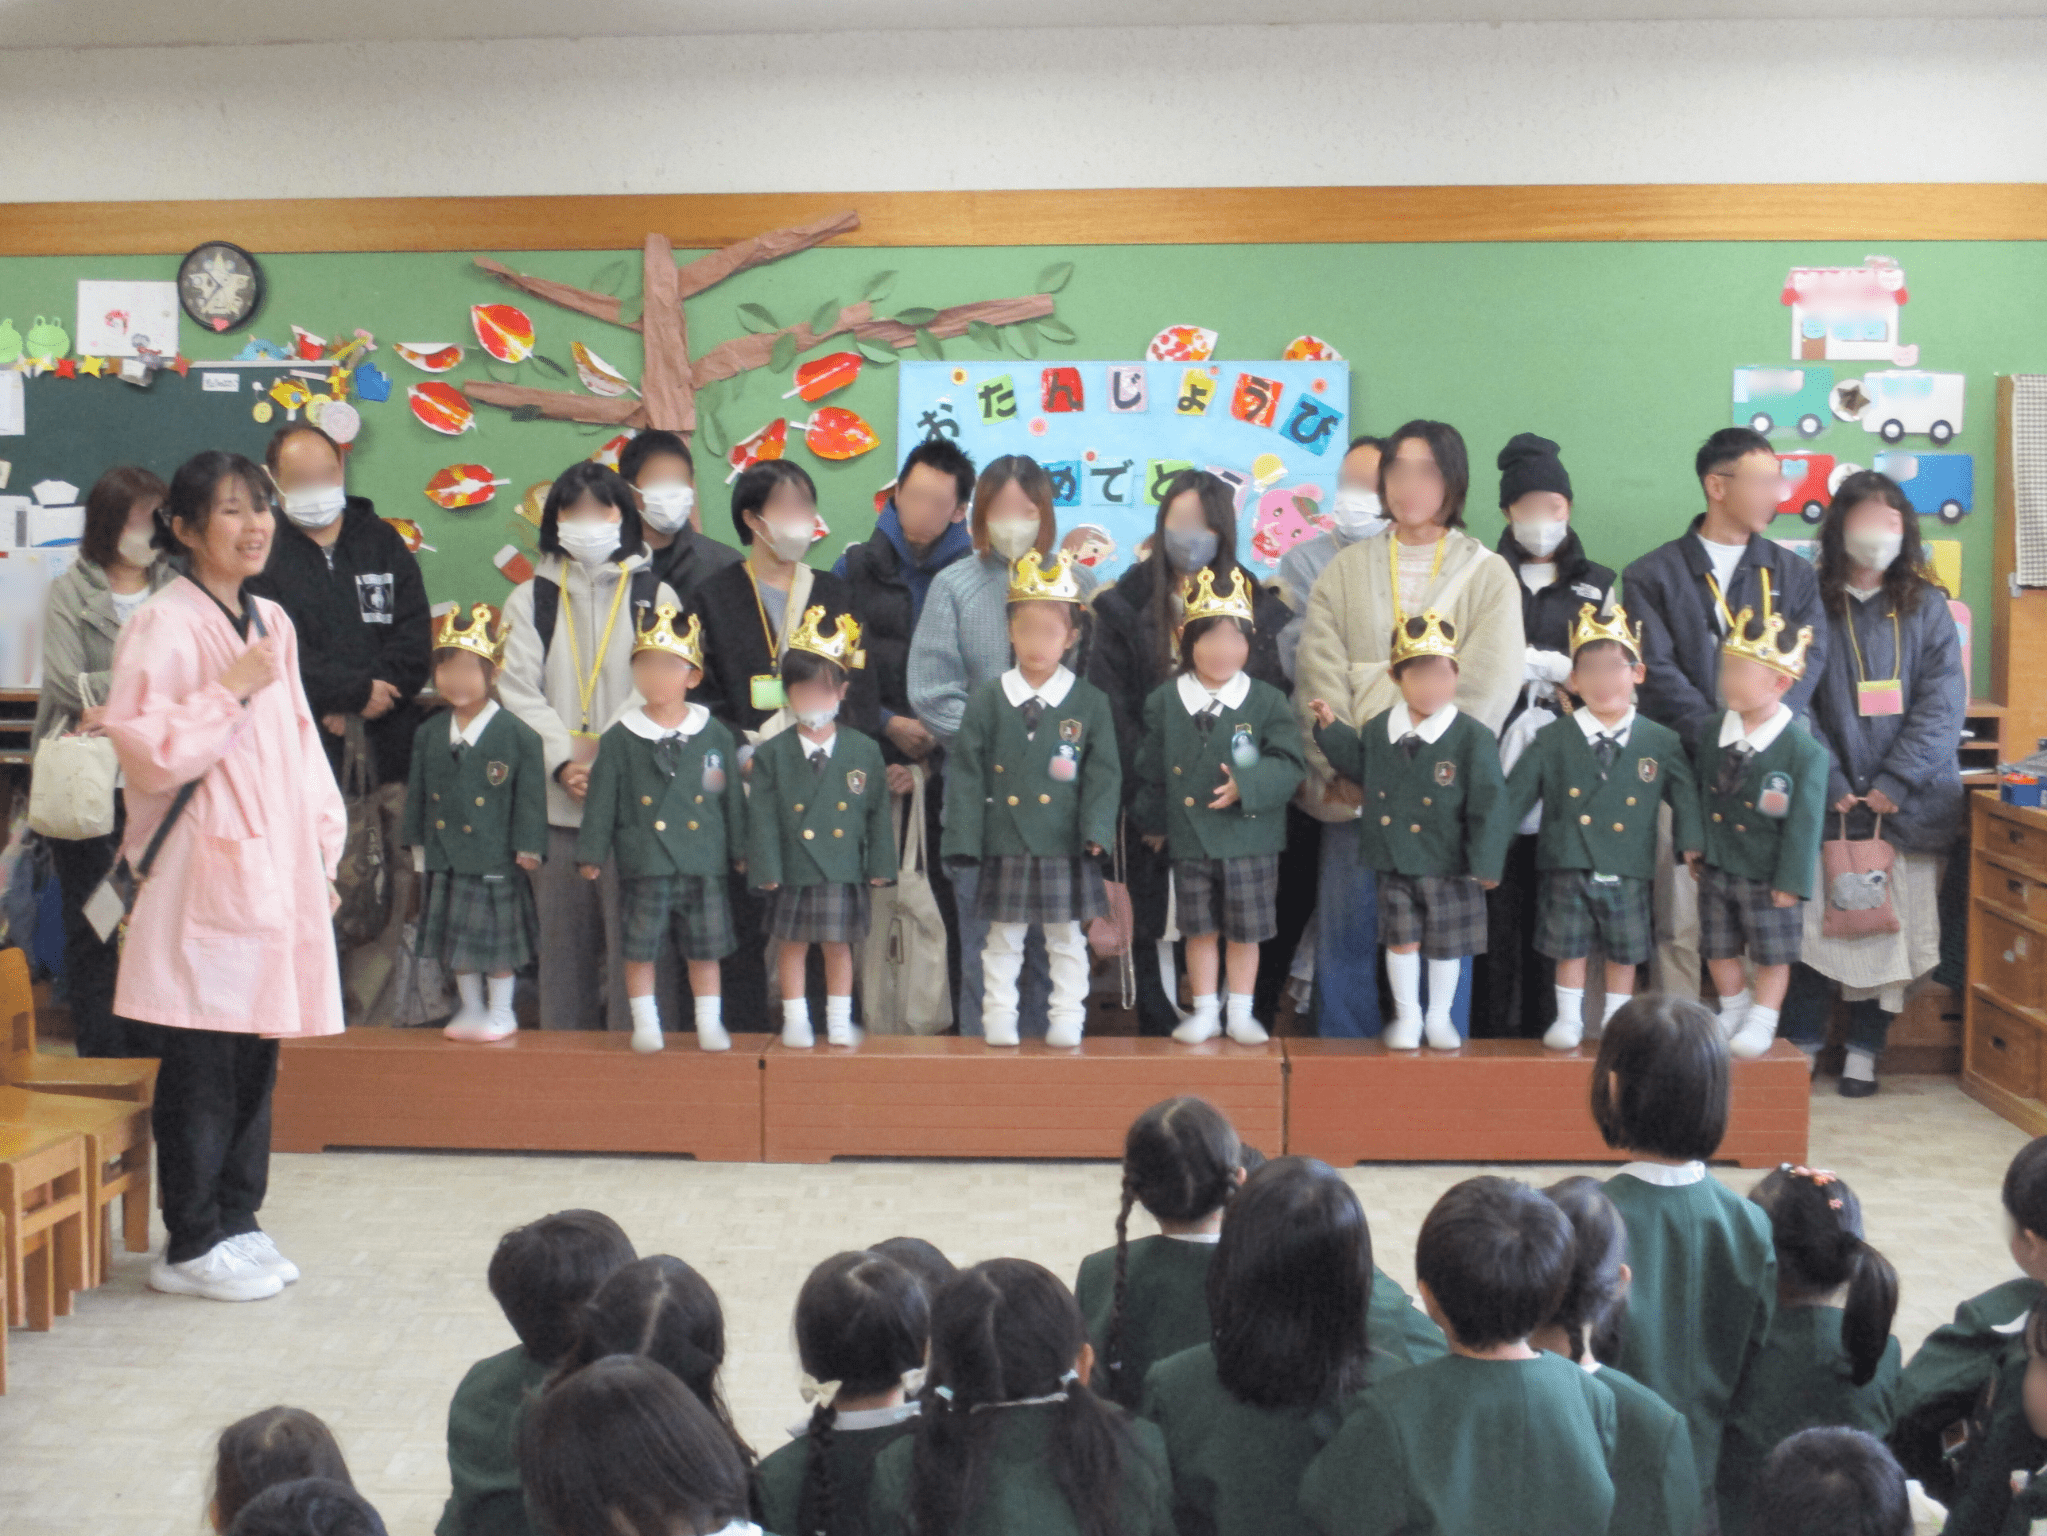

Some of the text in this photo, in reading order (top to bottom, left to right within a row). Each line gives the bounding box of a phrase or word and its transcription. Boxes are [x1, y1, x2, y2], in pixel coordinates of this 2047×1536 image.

[916, 370, 1339, 445] おたんじょうび
[1045, 458, 1243, 503] めでと
